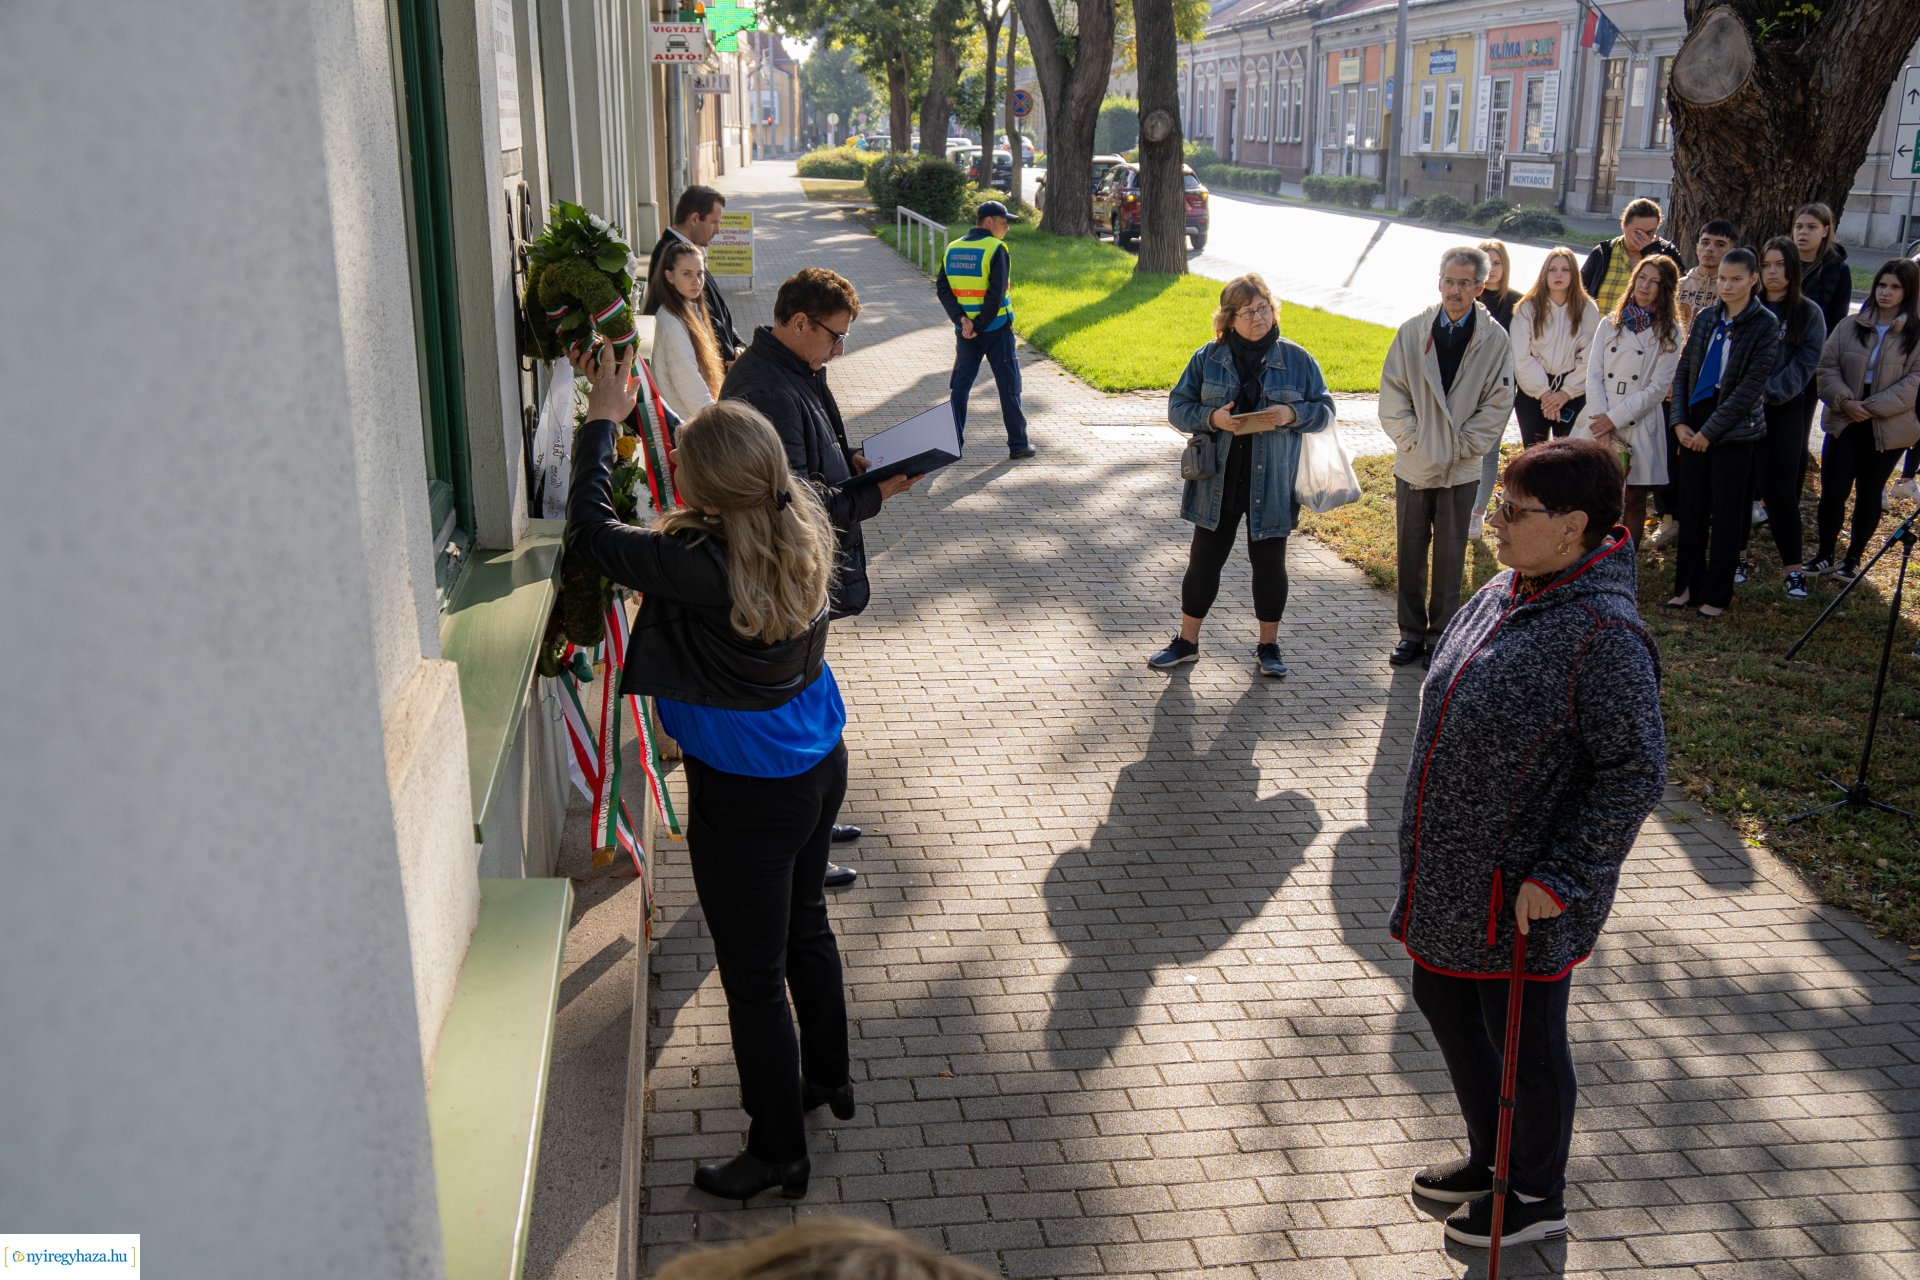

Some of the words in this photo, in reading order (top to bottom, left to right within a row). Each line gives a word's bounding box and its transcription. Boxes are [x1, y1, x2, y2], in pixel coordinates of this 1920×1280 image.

[653, 25, 701, 33] VIGYÁZZ
[654, 52, 702, 60] AUTÓ!
[1513, 175, 1550, 185] MINTABOLT
